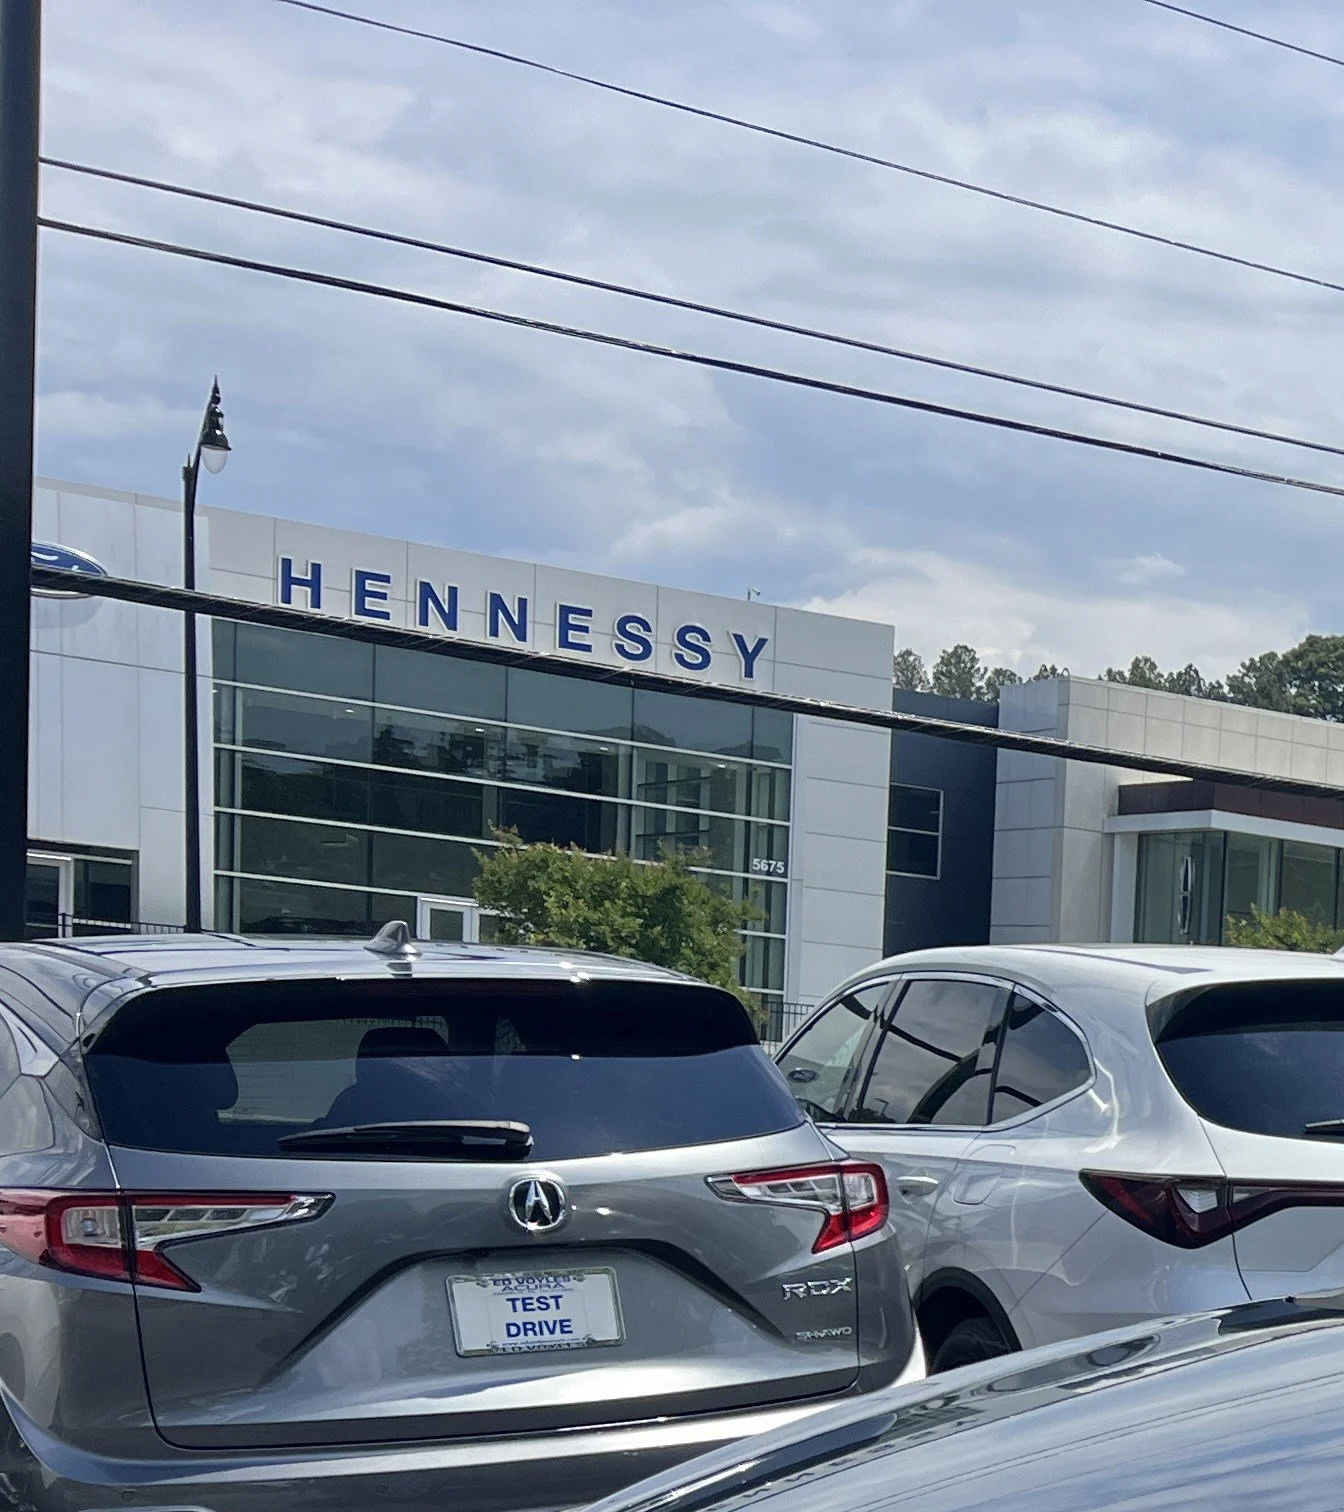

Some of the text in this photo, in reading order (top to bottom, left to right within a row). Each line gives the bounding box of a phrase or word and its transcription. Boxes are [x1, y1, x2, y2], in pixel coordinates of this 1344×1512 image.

[279, 557, 769, 679] HENNESSY
[752, 858, 785, 874] 5675
[782, 1277, 852, 1300] RDX
[506, 1294, 563, 1313] TEST
[505, 1319, 573, 1338] DRIVE
